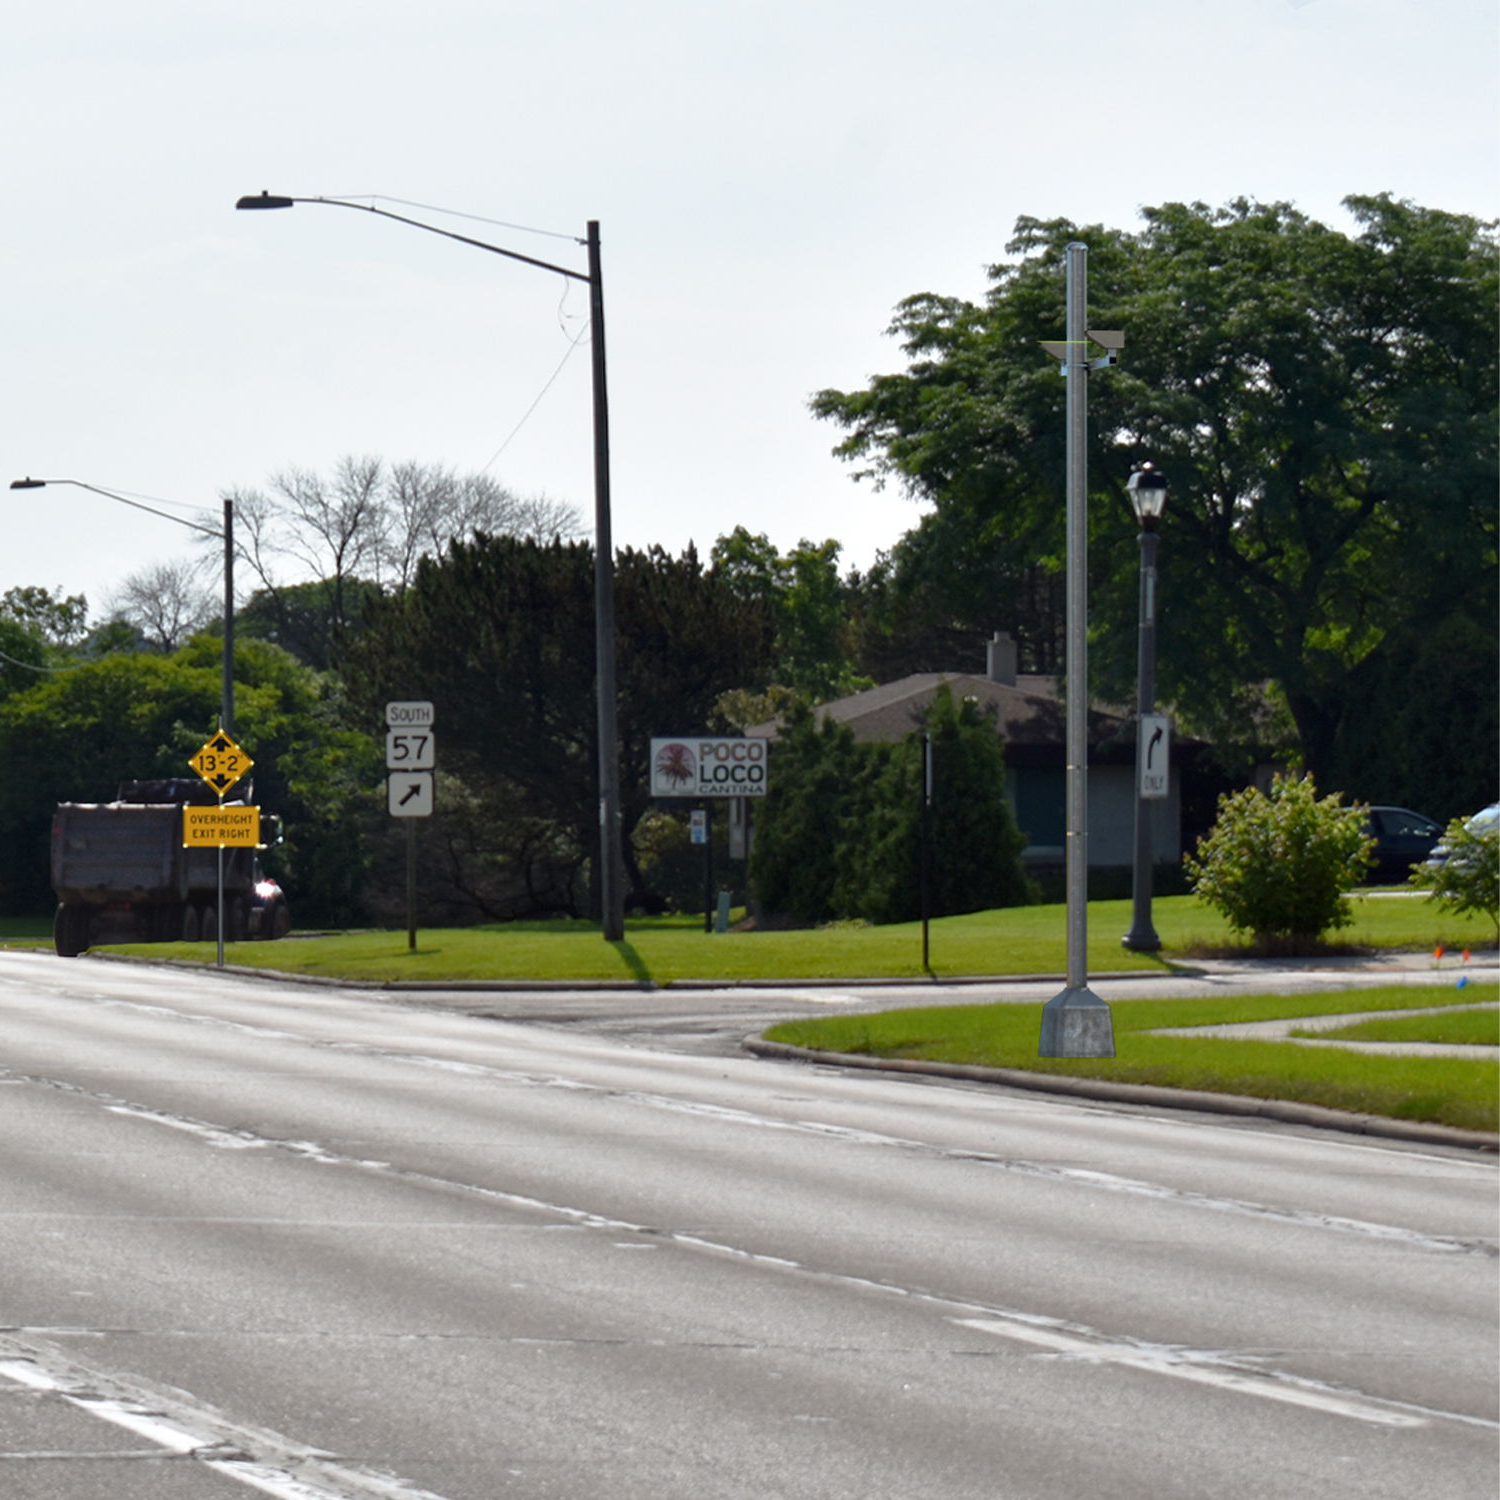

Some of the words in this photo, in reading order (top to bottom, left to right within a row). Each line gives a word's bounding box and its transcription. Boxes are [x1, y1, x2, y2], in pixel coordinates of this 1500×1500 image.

[390, 706, 430, 721] SOUTH
[393, 735, 428, 760] 57
[699, 742, 763, 762] POCO
[699, 764, 764, 783] LOCO
[699, 784, 763, 793] CANTINA
[189, 815, 253, 825] OVERHEIGHT
[192, 829, 215, 839] EXIT
[219, 829, 251, 839] RIGHT
